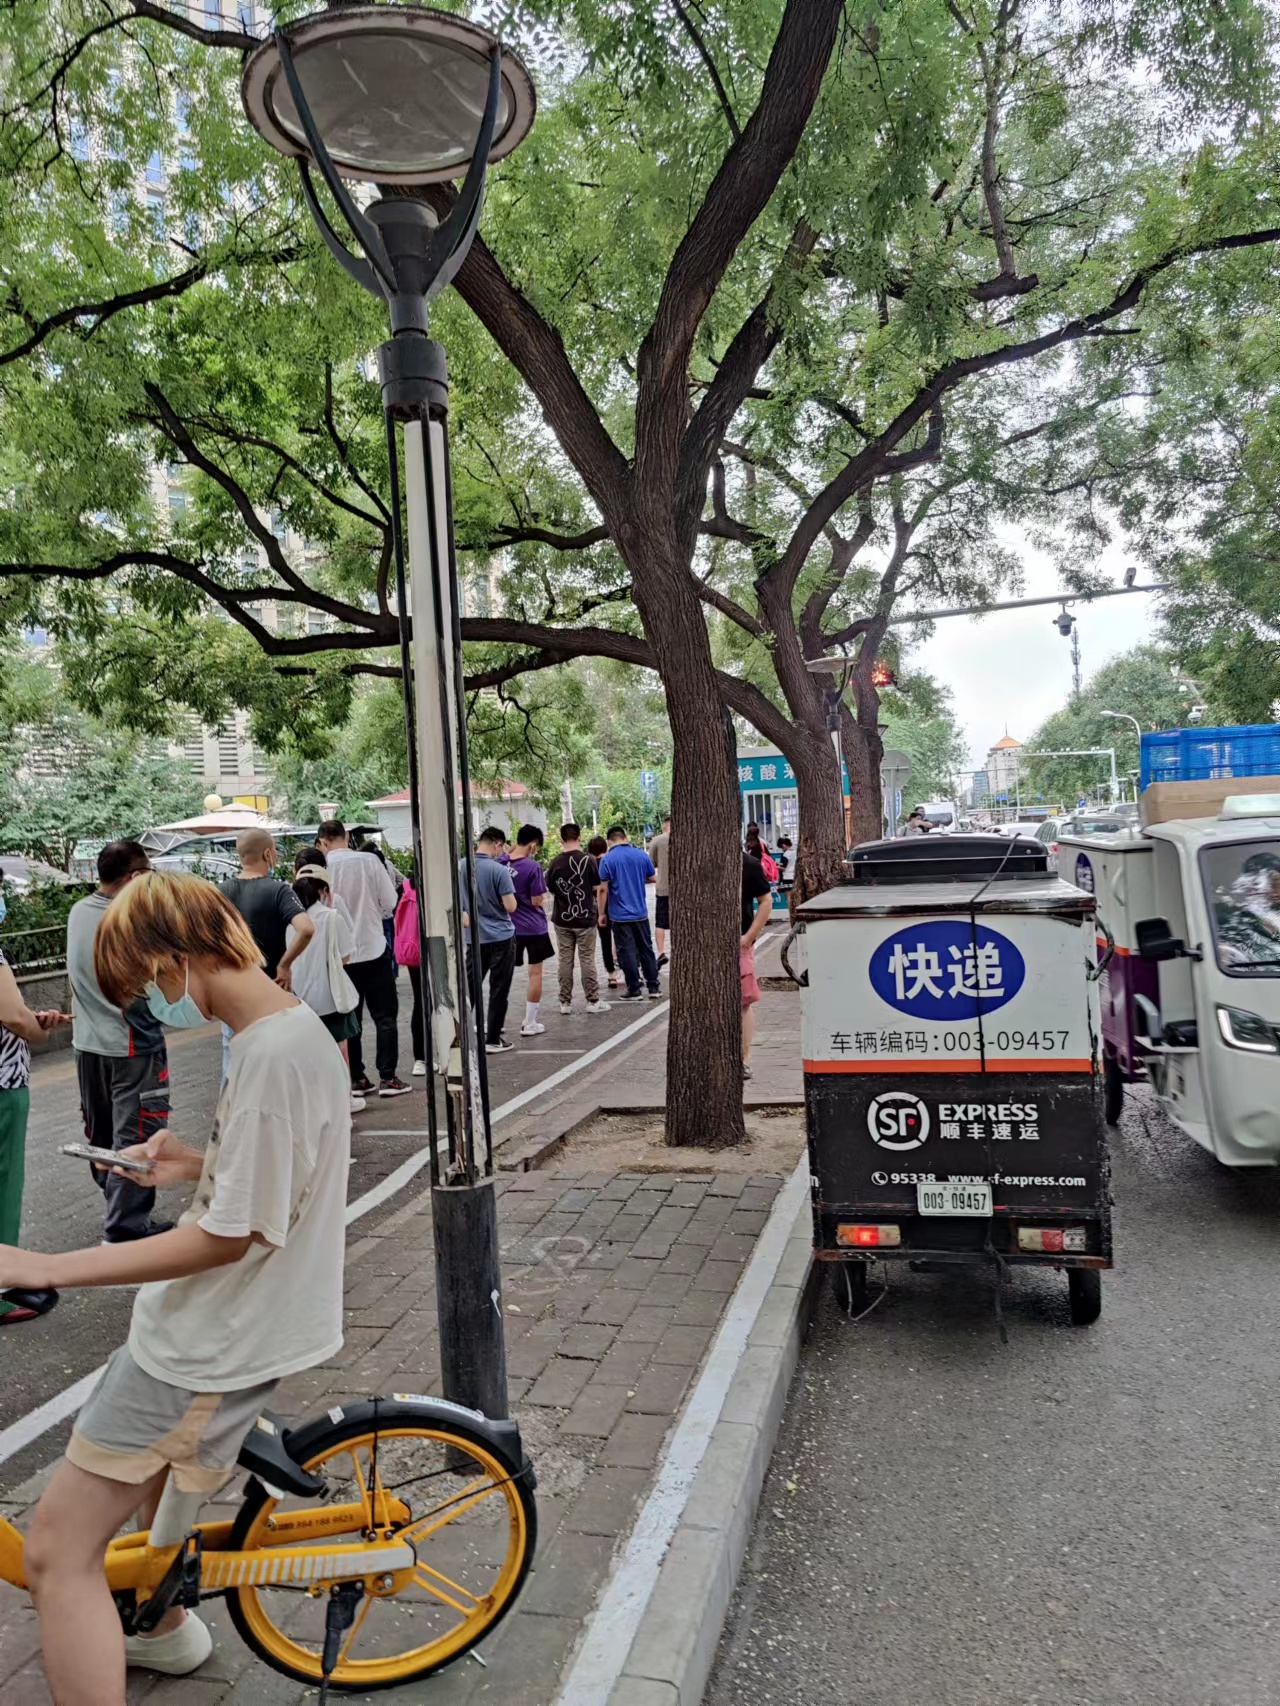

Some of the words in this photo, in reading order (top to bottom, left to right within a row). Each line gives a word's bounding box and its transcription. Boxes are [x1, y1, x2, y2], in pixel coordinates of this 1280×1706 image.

[887, 941, 1005, 999] 快递
[939, 1104, 1039, 1121] EXPRESS
[879, 1108, 918, 1136] SF
[940, 1122, 1040, 1140] 顺丰速运
[891, 1173, 936, 1184] 95338
[923, 1192, 987, 1210] 003-09457
